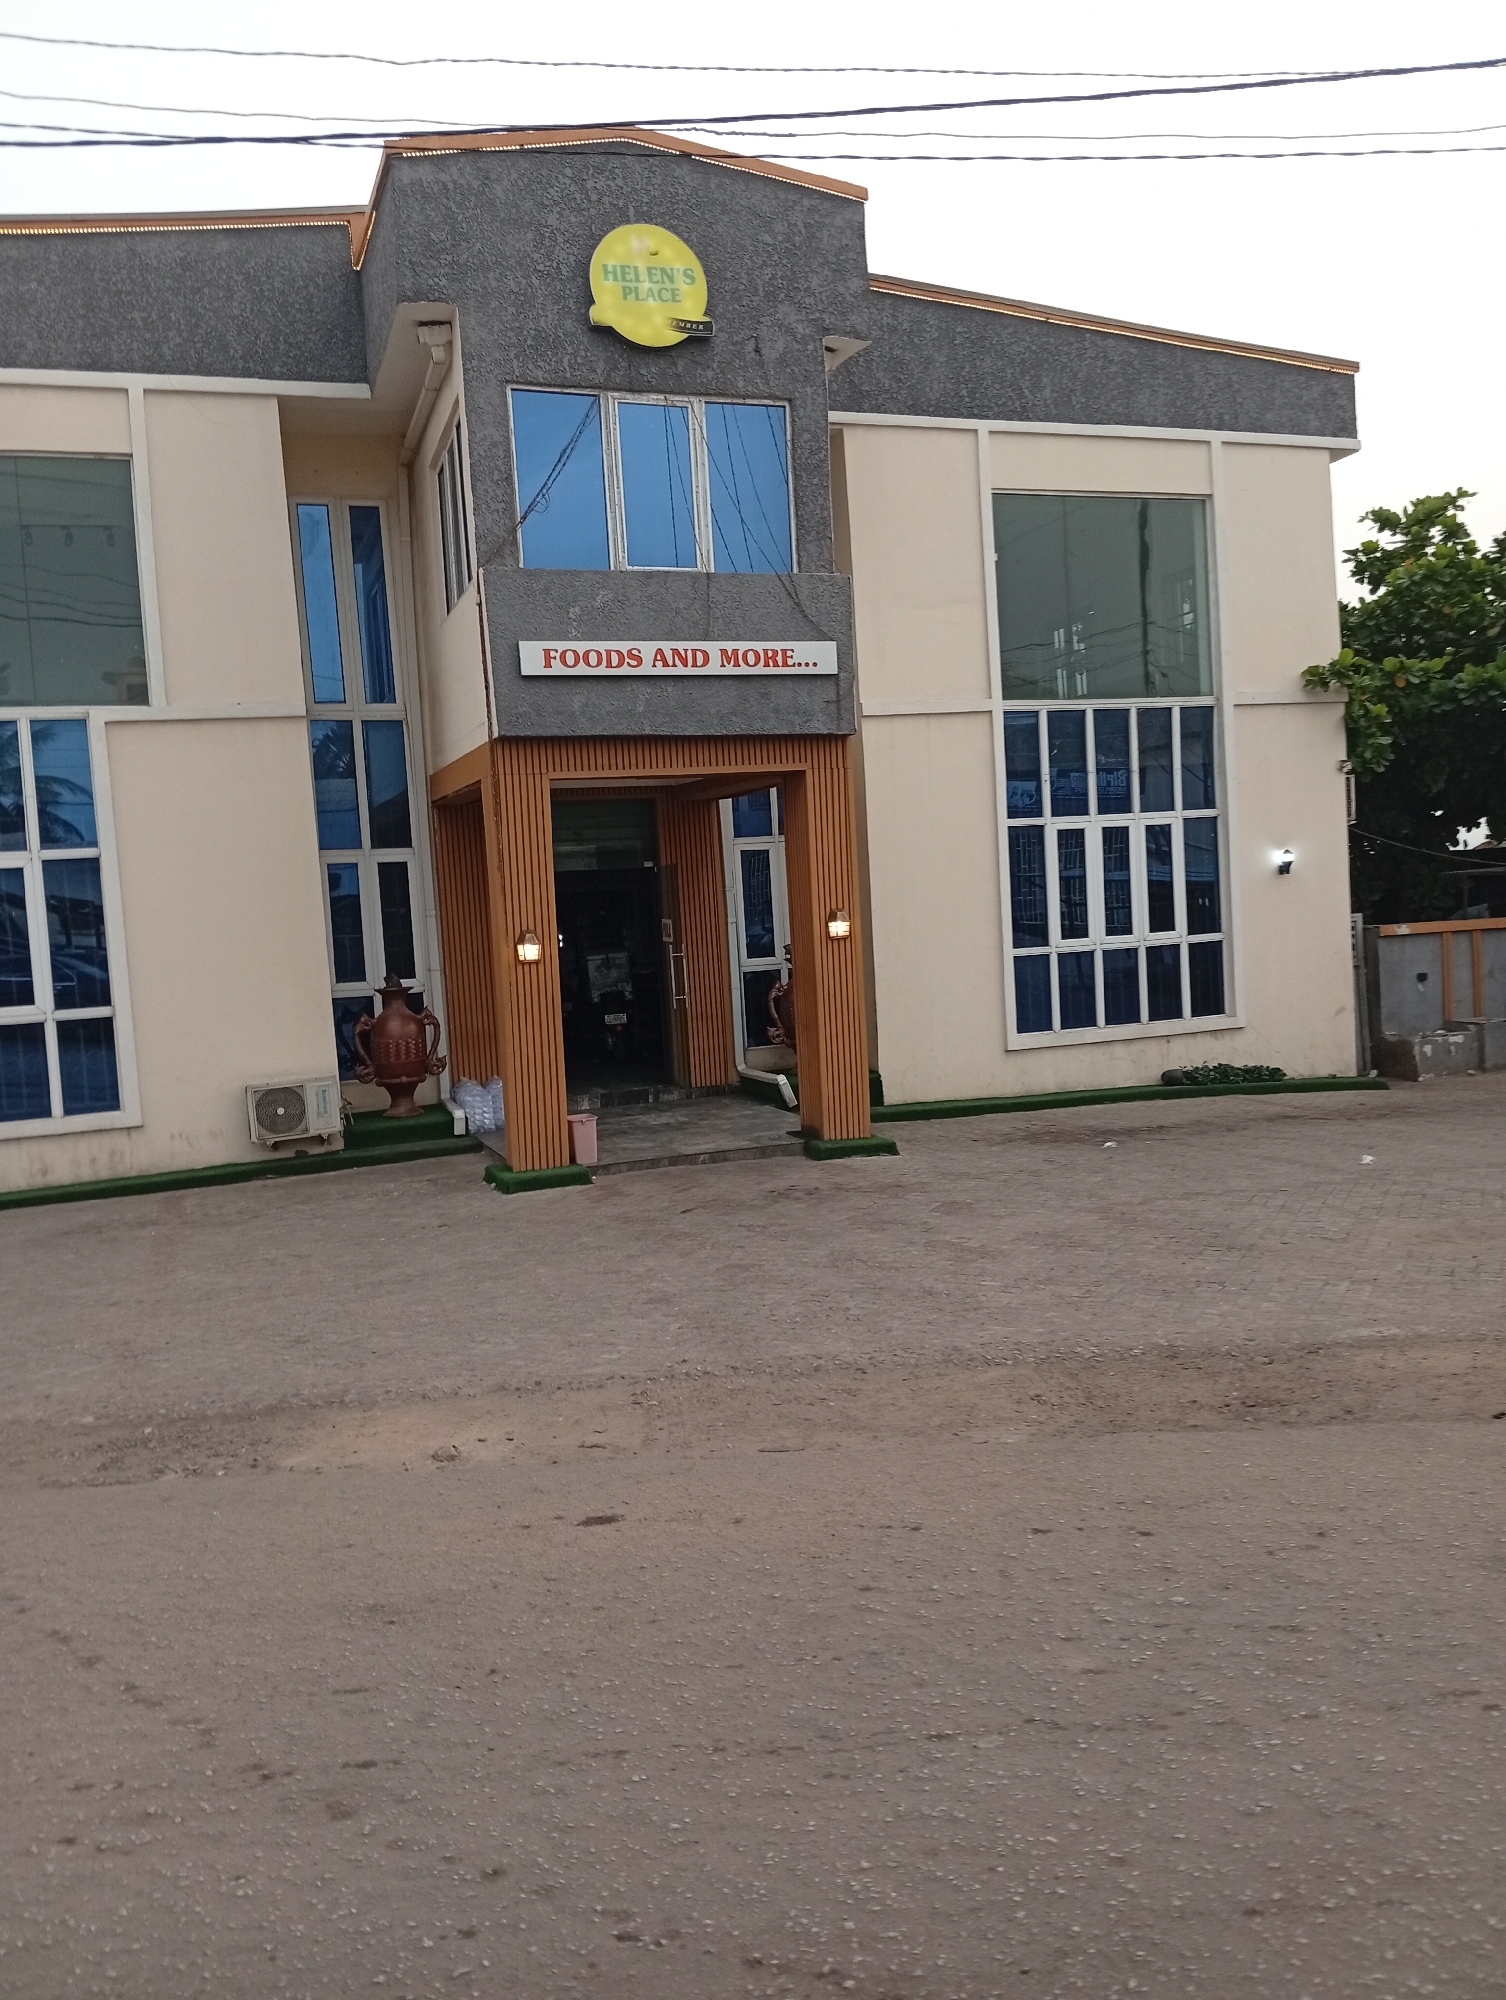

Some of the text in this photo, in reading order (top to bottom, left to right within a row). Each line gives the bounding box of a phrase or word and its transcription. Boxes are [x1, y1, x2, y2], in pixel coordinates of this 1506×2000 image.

[602, 264, 696, 286] HELEN'S
[621, 285, 682, 303] PLACE
[542, 647, 818, 669] FOODS AND MORE...
